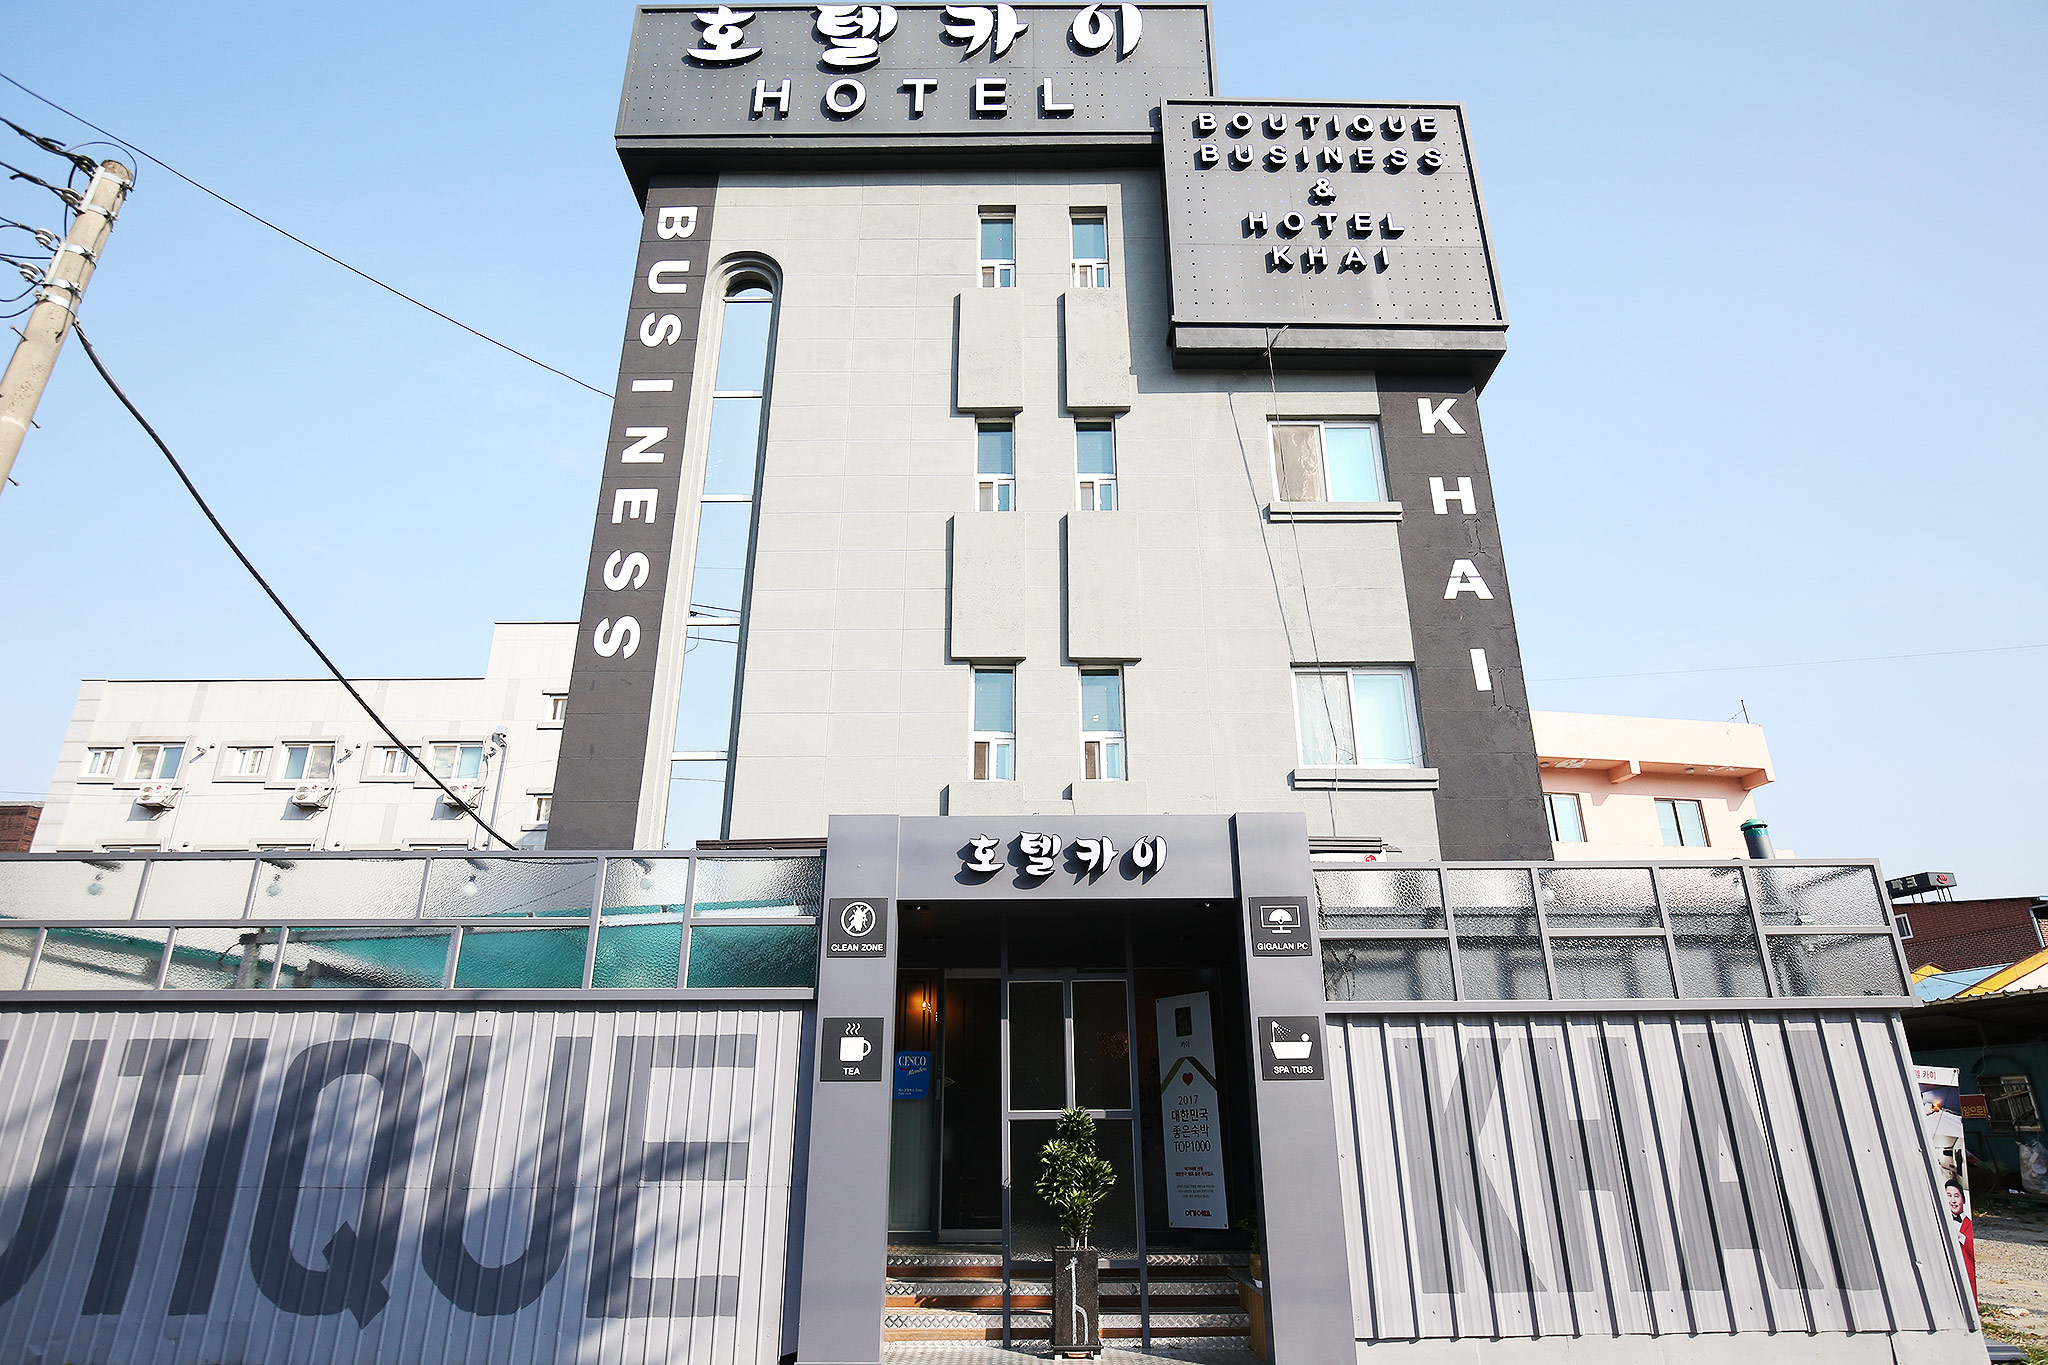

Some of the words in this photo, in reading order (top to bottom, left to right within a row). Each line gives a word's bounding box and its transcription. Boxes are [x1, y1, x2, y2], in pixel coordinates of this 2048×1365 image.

[687, 3, 1143, 66] 호텔카이
[753, 77, 1075, 113] HOTEL
[1198, 112, 1438, 133] BOUTIQUE
[1200, 144, 1444, 167] BUSINESS
[1313, 177, 1336, 197] &
[1248, 211, 1405, 231] HOTEL
[1272, 245, 1391, 266] KHAI
[593, 206, 698, 659] BUSINESS
[1417, 398, 1494, 691] KHAI
[966, 831, 1167, 876] 호텔카이
[830, 943, 859, 952] CLEAN
[860, 943, 884, 952] ZONE
[1257, 942, 1295, 951] GIGALAN
[1296, 942, 1309, 950] PC
[898, 1055, 927, 1067] CESCO
[1273, 1065, 1290, 1075] SPA
[1291, 1065, 1314, 1074] TUBS
[843, 1067, 861, 1076] TEA
[1178, 1094, 1199, 1106] 2017
[1171, 1107, 1209, 1123] 대한민국
[1173, 1123, 1210, 1139] 좋은숙박
[1173, 1139, 1211, 1153] TOP1000
[1392, 1029, 1880, 1294] KHAI
